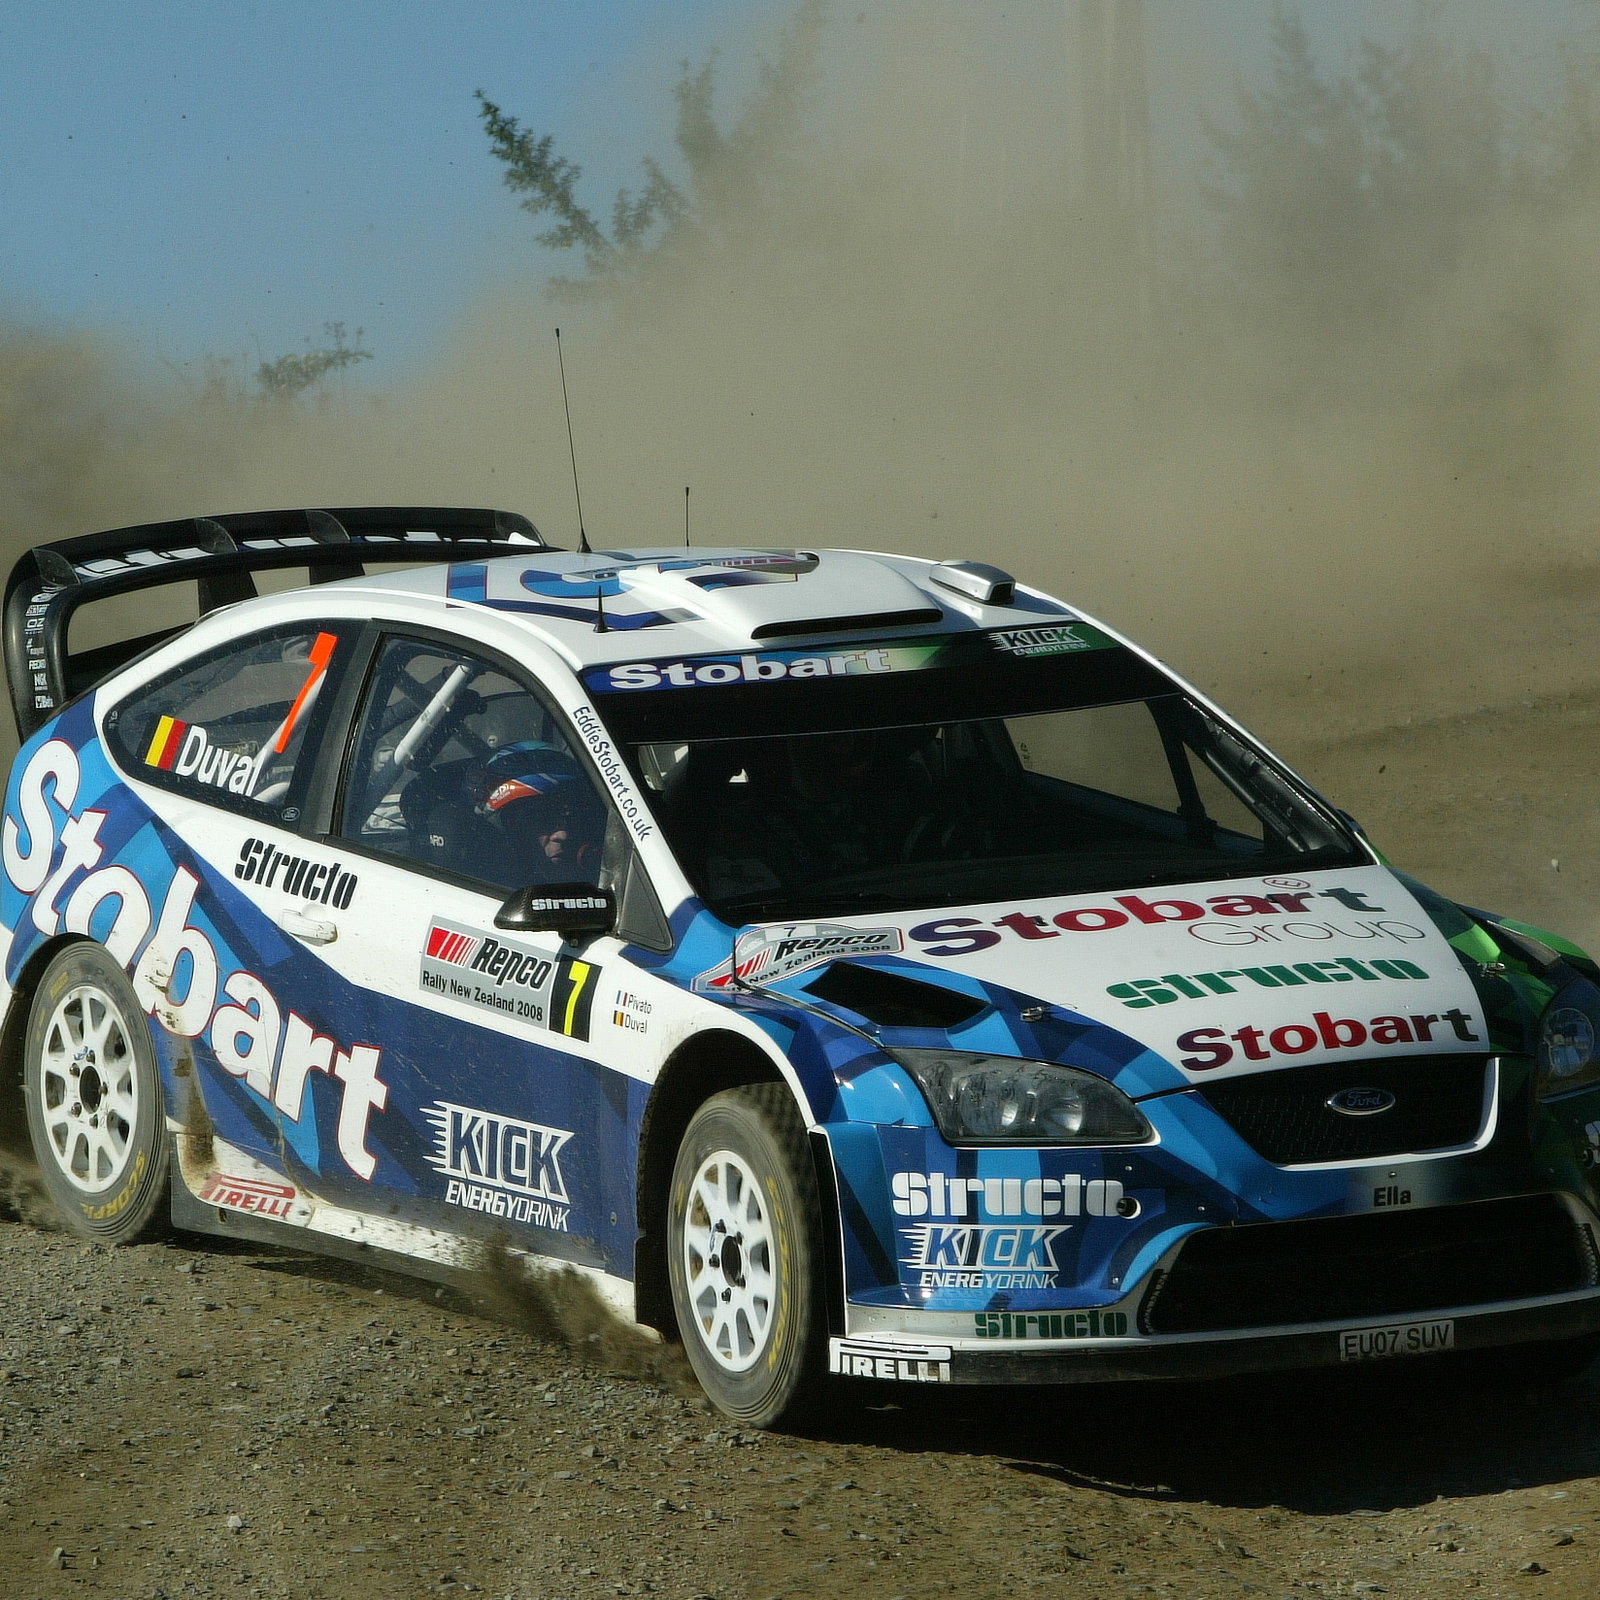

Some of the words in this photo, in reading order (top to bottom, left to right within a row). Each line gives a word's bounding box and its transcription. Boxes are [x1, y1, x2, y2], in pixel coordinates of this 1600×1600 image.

[609, 649, 890, 689] Stobart
[175, 724, 264, 797] Duval
[573, 706, 653, 841] EddieStobart.co.uk
[234, 837, 358, 910] Structo
[784, 927, 796, 938] 7
[908, 887, 1386, 957] Stobart
[1187, 918, 1426, 947] Group
[2, 738, 388, 1181] Stobart
[470, 937, 553, 990] Repco
[749, 969, 779, 985] New
[785, 947, 846, 970] Zealand
[774, 934, 888, 962] Repco
[422, 971, 448, 993] Rally
[450, 981, 472, 998] New
[475, 987, 514, 1012] Zealand
[517, 1001, 543, 1021] 2008
[563, 960, 590, 1037] 7
[627, 995, 653, 1014] Pivato
[625, 1014, 648, 1033] Duval
[1176, 1008, 1480, 1072] Stobart
[433, 1101, 575, 1204] KICK
[198, 1171, 296, 1218] PIRELLI
[892, 1172, 1124, 1217] Structo
[1373, 1186, 1411, 1207] Ella
[903, 1223, 1073, 1271] KICK
[829, 1336, 952, 1383] PIRELLI
[1344, 1330, 1400, 1357] EU07
[1407, 1324, 1450, 1350] SUV
